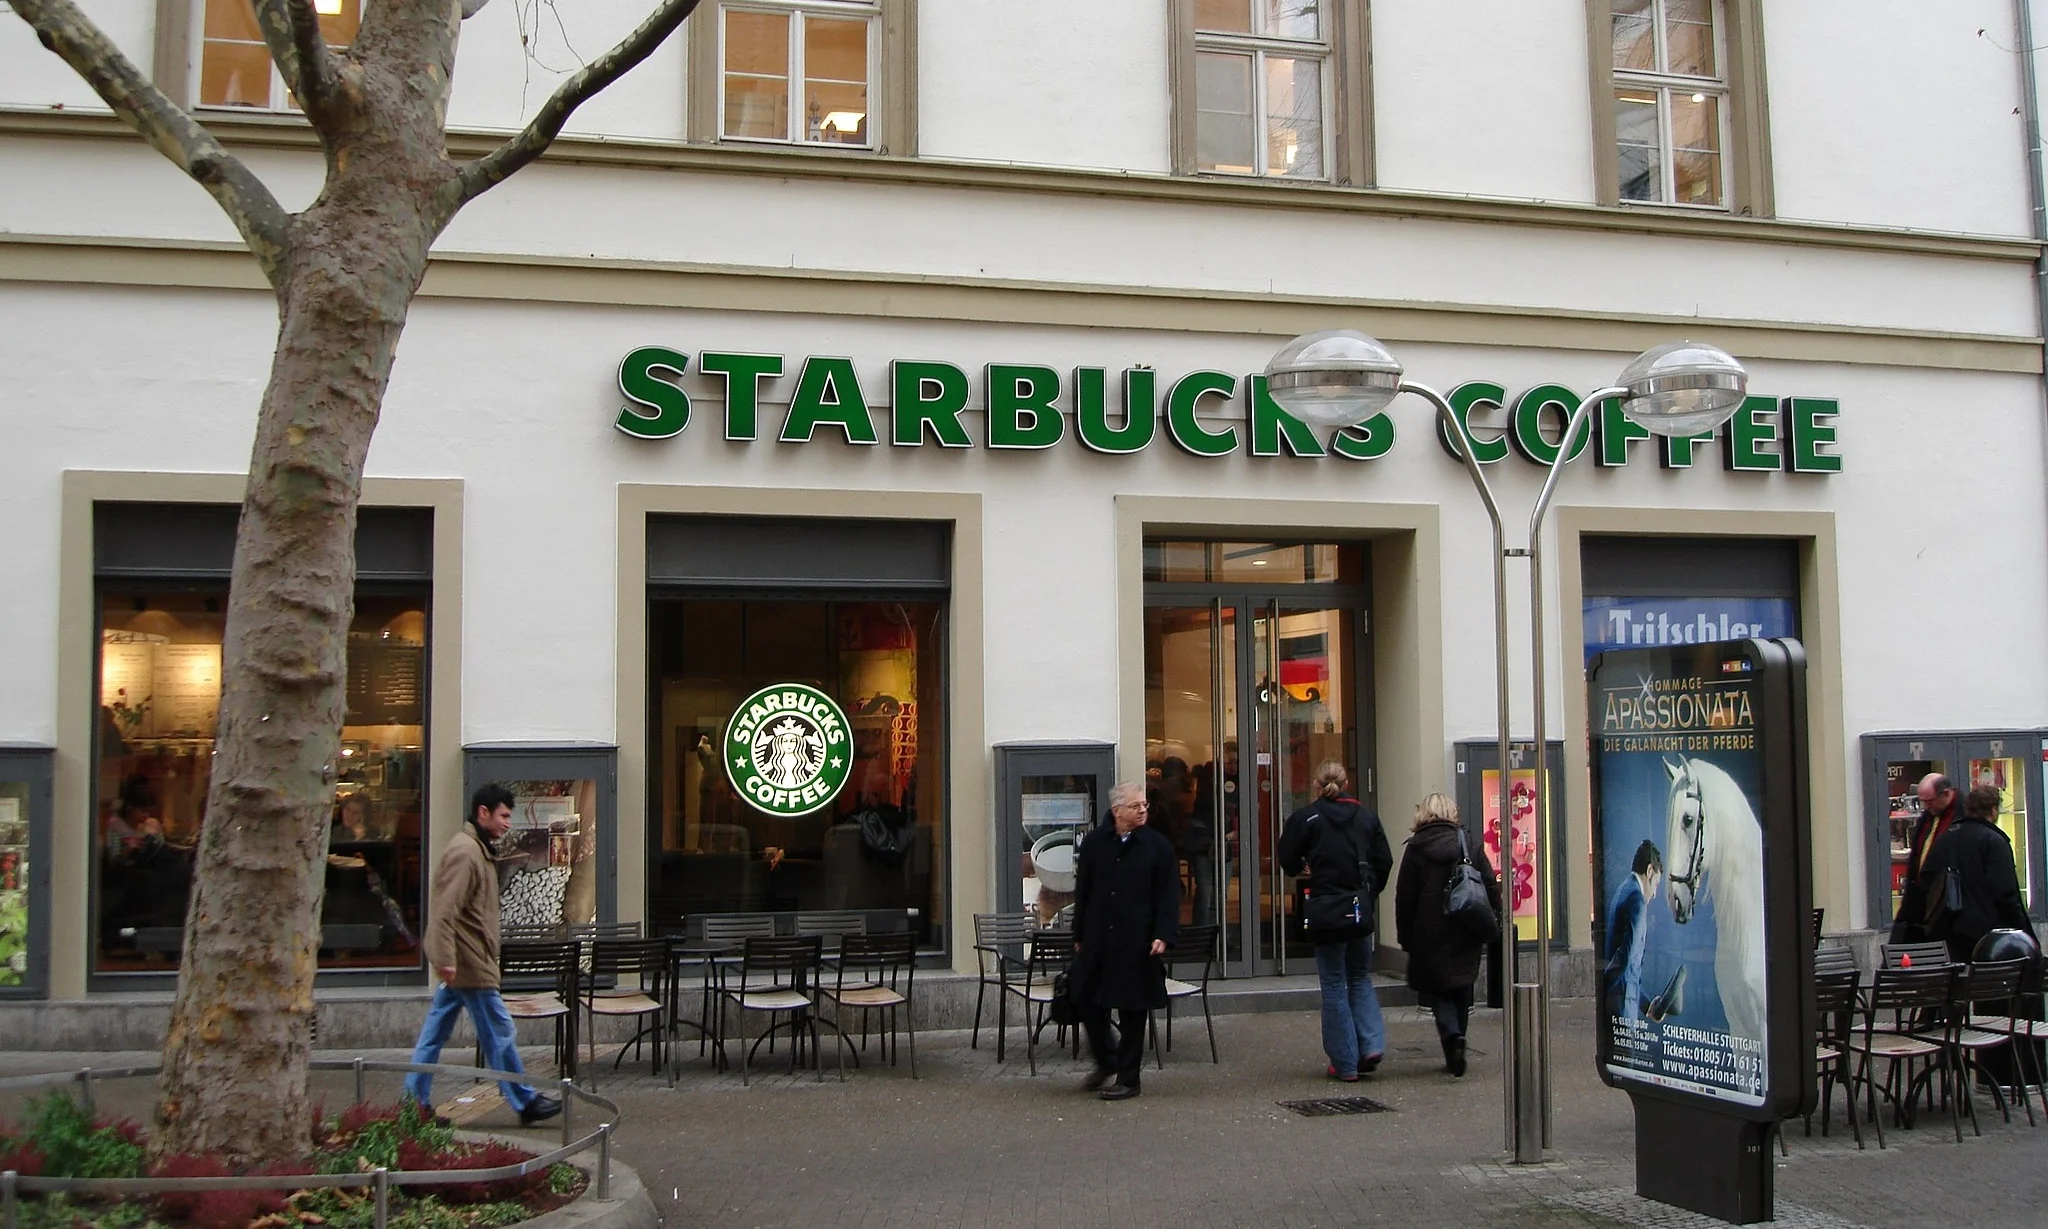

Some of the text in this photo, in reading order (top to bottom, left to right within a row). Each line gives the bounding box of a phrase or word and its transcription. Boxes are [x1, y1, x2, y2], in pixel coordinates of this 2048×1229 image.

[1608, 610, 1762, 644] Tritschler
[1649, 677, 1702, 692] HOMMAGE
[733, 691, 845, 745] STARBUCKS
[1603, 690, 1754, 730] APASSIONATA
[1604, 734, 1754, 752] DIE GALANACHT DER PFERDE
[745, 775, 831, 808] COFFEE
[1662, 1024, 1761, 1053] SCHLEYERHALLE STUTTGART
[1662, 1040, 1693, 1060] Tickets:
[1693, 1046, 1720, 1065] 01805
[1726, 1052, 1737, 1068] 71
[1738, 1055, 1749, 1070] 61
[1751, 1057, 1762, 1073] 51
[1662, 1058, 1760, 1089] www.apassionata.de
